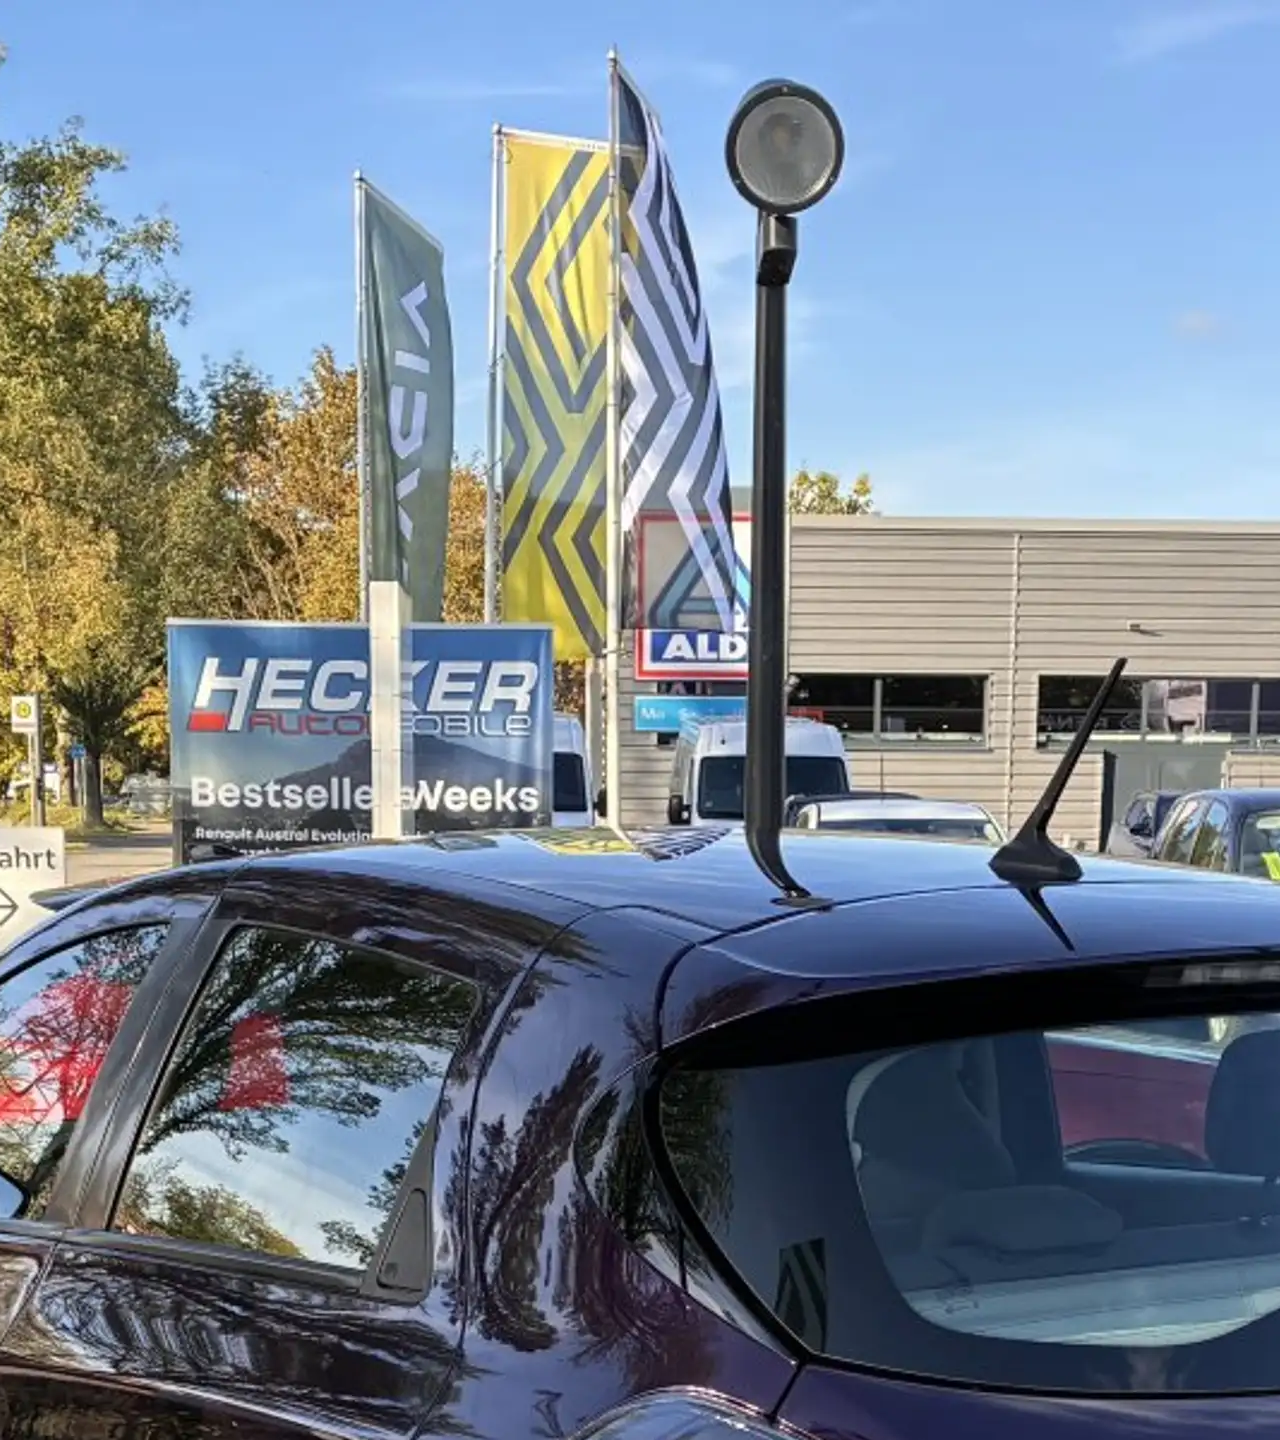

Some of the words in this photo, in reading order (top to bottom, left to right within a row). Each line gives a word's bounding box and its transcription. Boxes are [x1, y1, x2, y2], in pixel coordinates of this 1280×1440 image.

[661, 632, 748, 660] ALD
[191, 776, 373, 811] Bestselle
[195, 827, 252, 842] Renault
[255, 828, 309, 843] Austral
